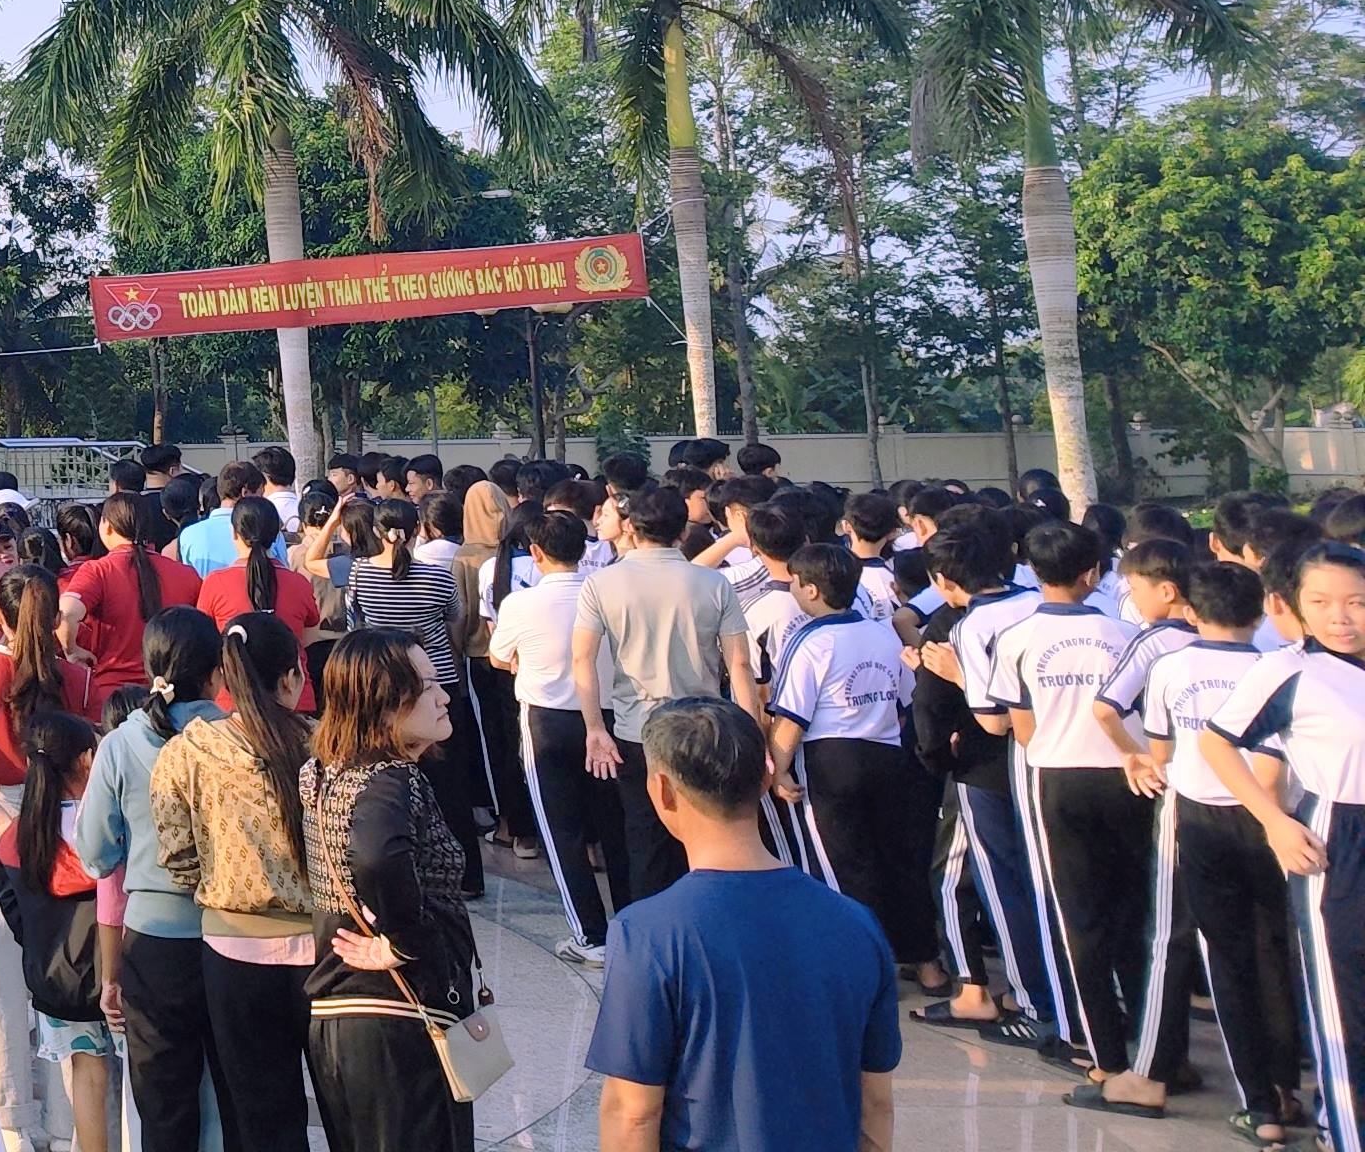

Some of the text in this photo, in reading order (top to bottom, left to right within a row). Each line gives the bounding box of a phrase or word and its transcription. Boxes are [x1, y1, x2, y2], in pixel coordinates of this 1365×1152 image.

[179, 284, 218, 318] TOÀN
[219, 283, 249, 316] DÂN
[249, 279, 281, 314] RÈN
[281, 276, 325, 317] LUYỆN
[326, 273, 363, 307] THÂN
[363, 263, 391, 304] THỂ
[391, 273, 427, 302] THEO
[476, 260, 504, 295] BÁC
[502, 256, 524, 292] HỒ
[523, 256, 540, 290] VĨ
